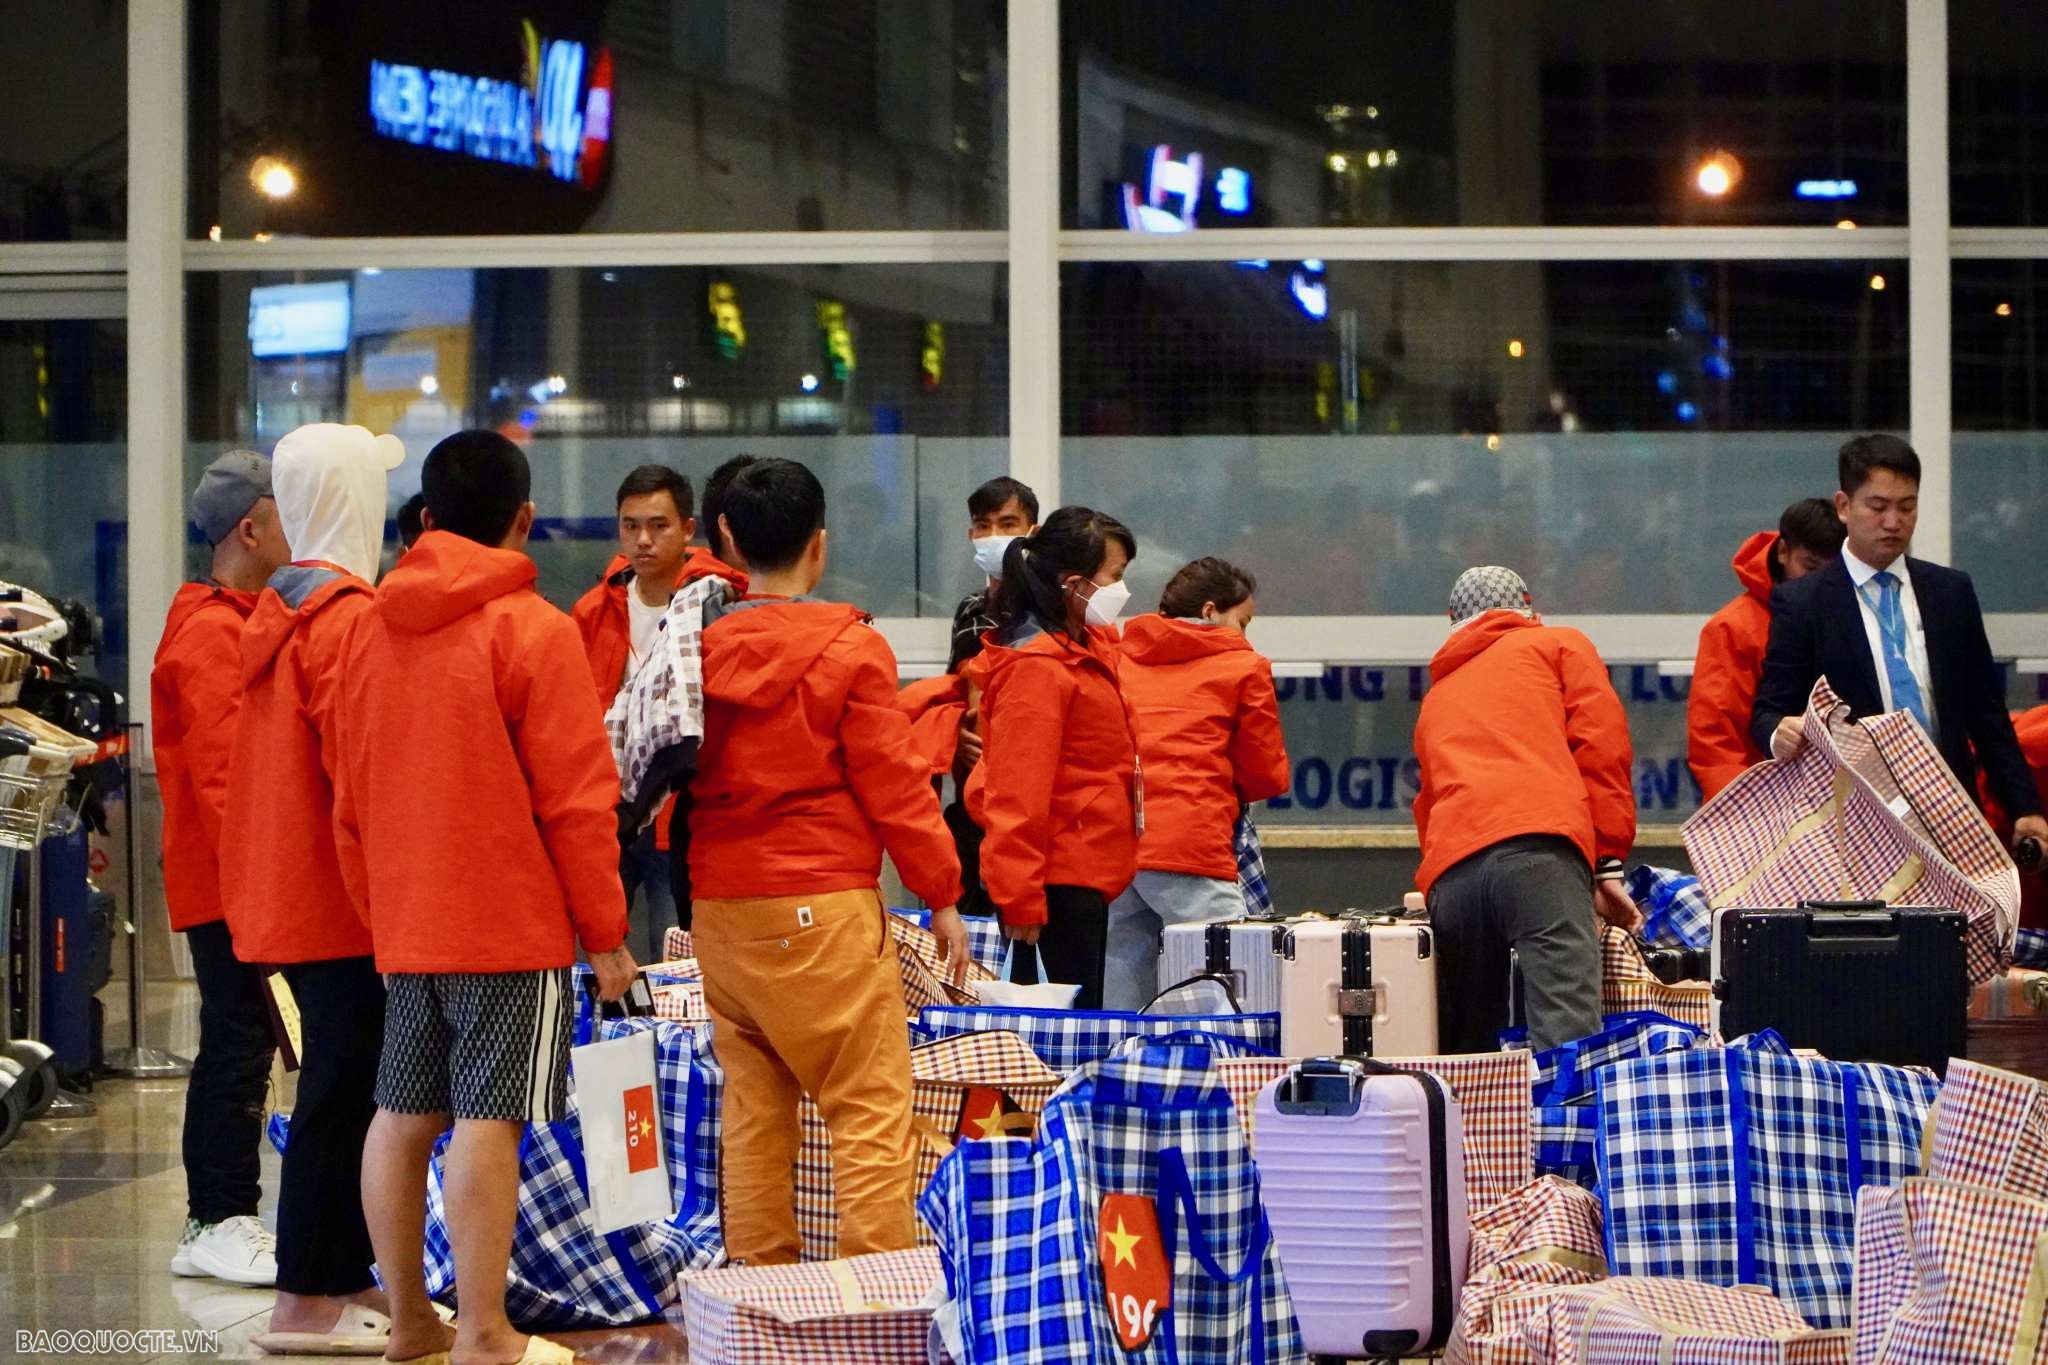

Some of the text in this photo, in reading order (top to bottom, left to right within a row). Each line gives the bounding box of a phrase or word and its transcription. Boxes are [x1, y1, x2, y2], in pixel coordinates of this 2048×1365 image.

[1276, 666, 1384, 701] NG
[1267, 757, 1421, 810] OGI
[628, 1110, 639, 1147] 210
